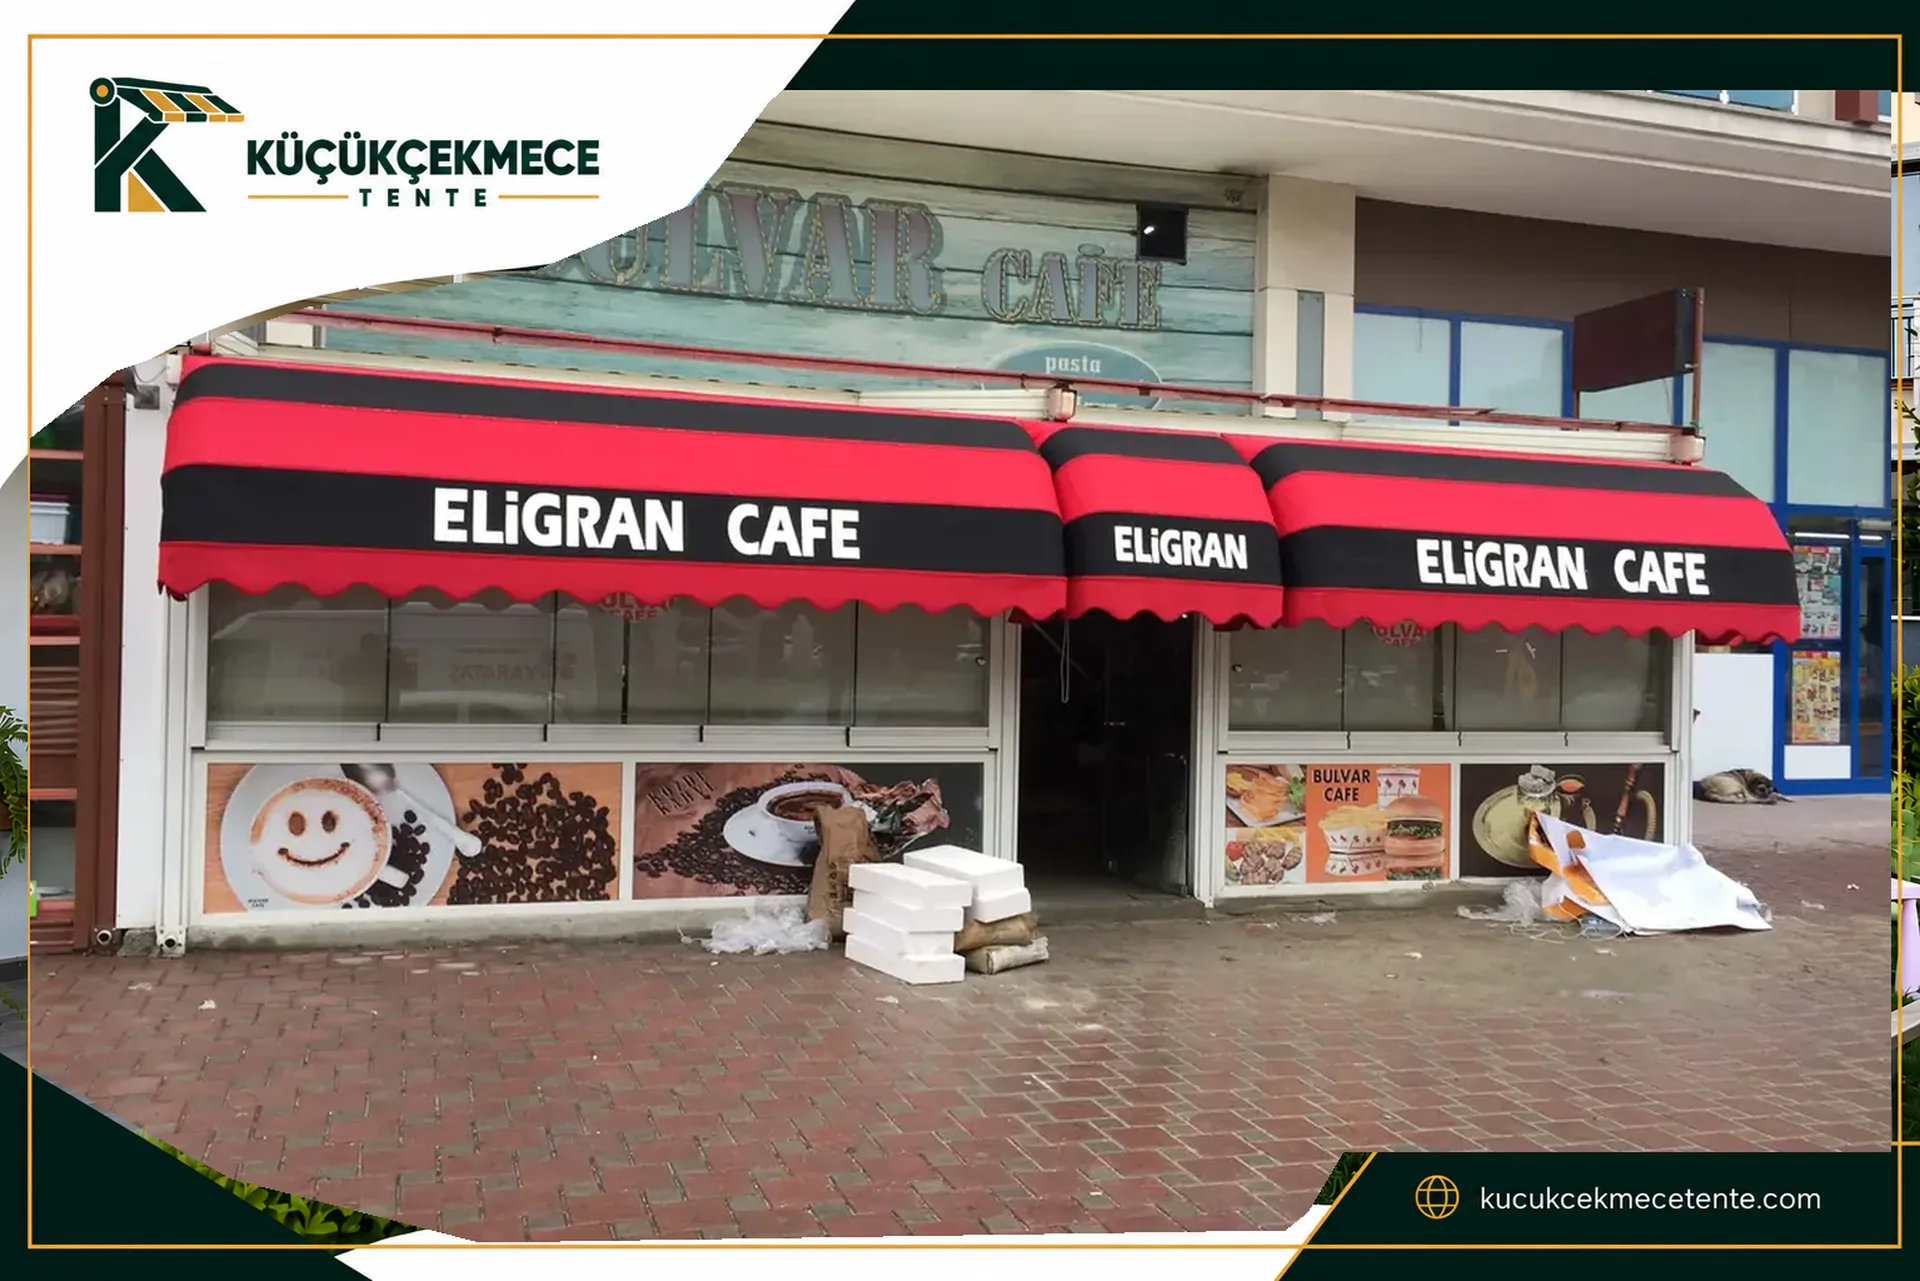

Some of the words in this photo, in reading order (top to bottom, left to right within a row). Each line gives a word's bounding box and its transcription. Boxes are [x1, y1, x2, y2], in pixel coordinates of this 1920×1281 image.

[1044, 355, 1101, 373] pasta
[727, 503, 861, 560] CAFE
[1614, 549, 1710, 595] CAFE
[1313, 768, 1371, 784] BULVAR
[1324, 787, 1359, 802] CAFE
